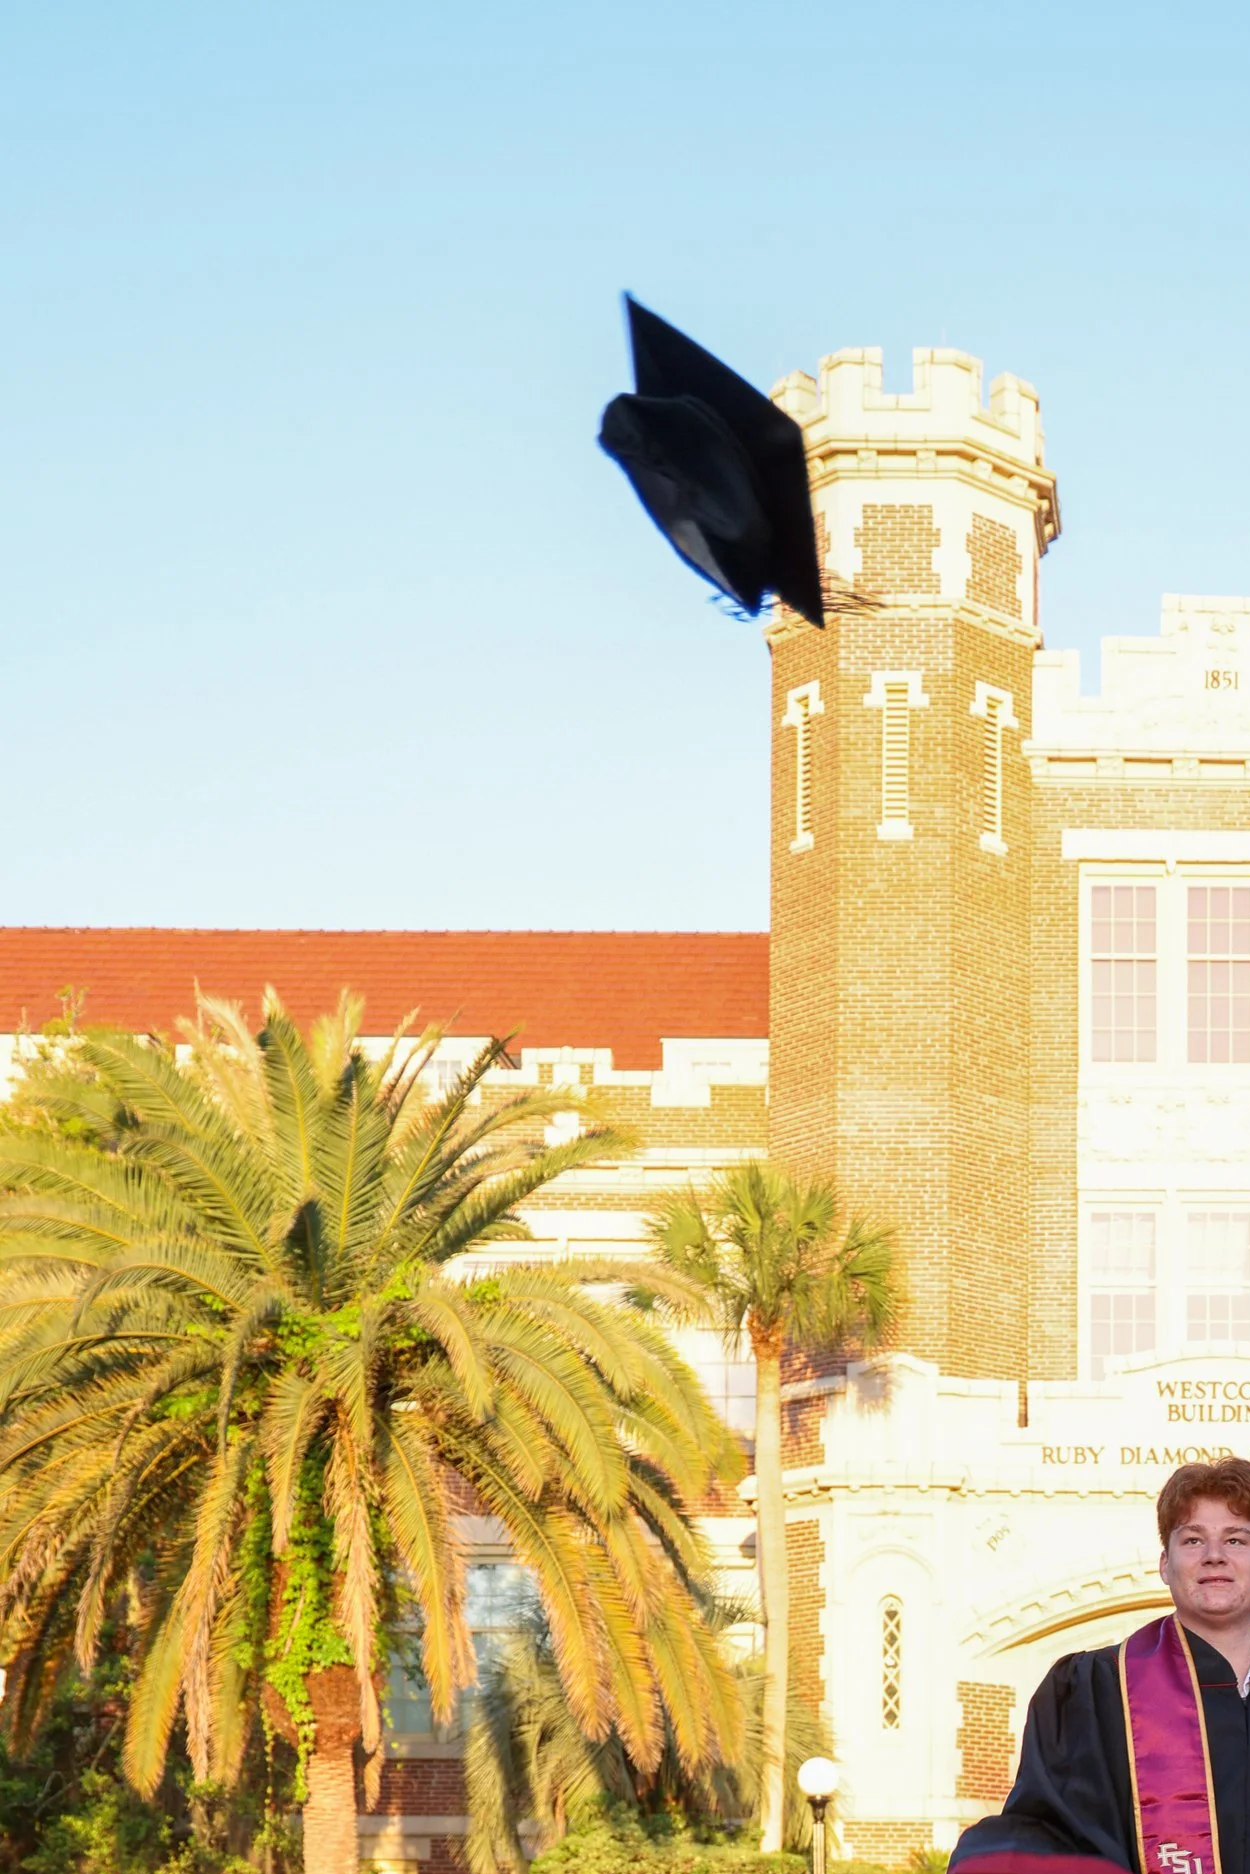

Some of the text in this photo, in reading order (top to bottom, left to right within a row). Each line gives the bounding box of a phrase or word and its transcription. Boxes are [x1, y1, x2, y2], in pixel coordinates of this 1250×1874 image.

[1204, 669, 1239, 691] 1851
[1041, 1446, 1106, 1465] RUBY
[1119, 1446, 1237, 1466] DIAMOND
